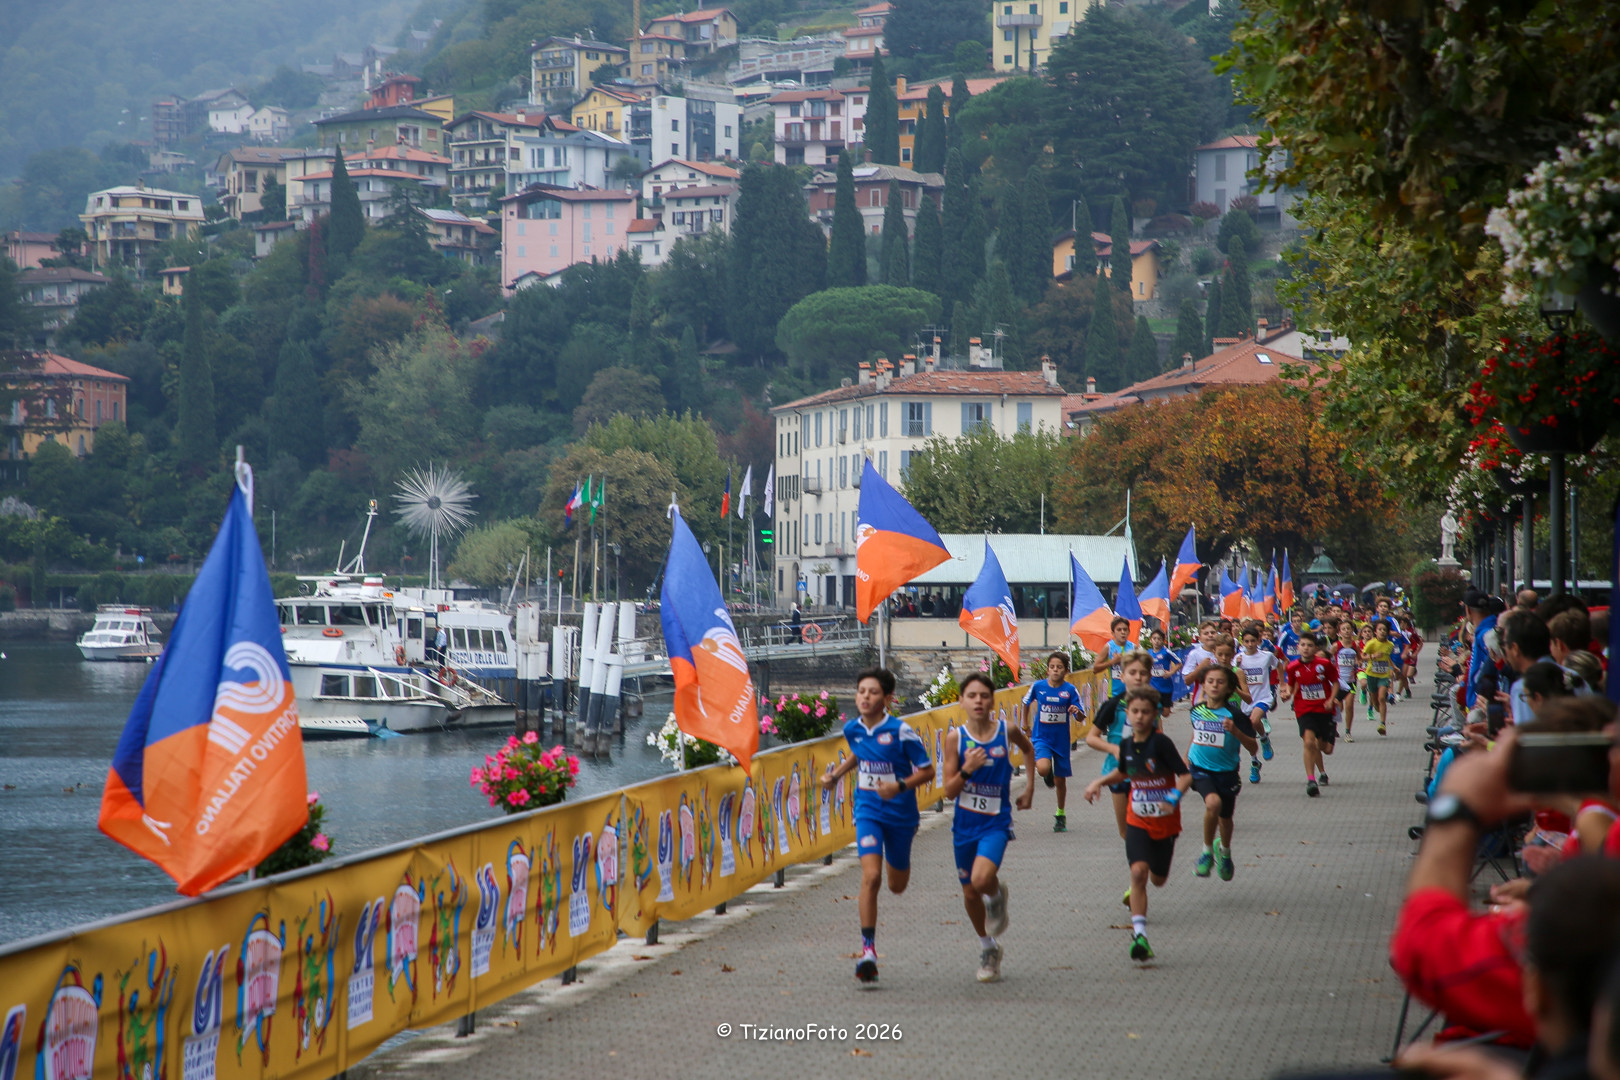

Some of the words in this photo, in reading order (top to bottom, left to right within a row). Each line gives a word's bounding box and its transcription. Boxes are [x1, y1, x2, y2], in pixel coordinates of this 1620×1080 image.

[1047, 713, 1059, 722] 22
[1197, 731, 1217, 744] 390
[971, 796, 987, 810] 18
